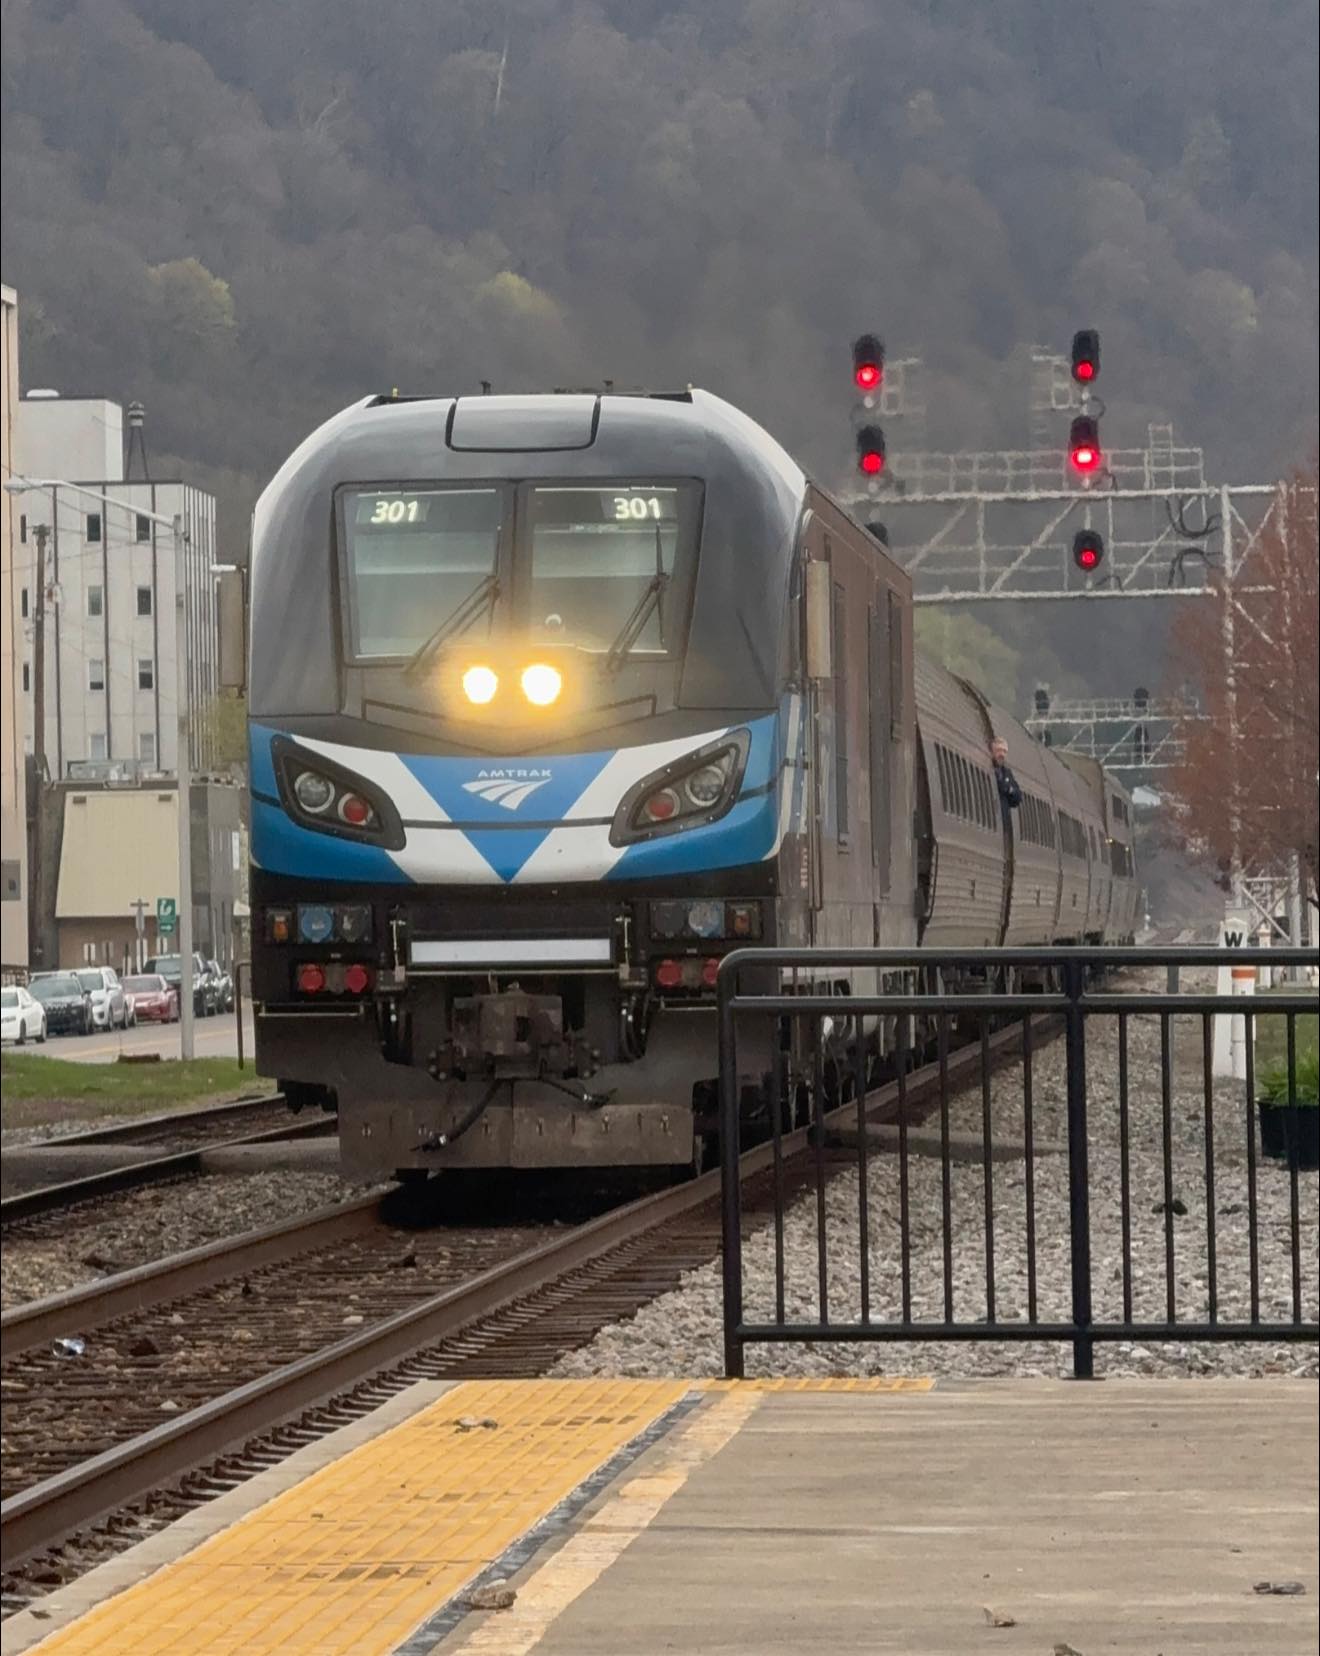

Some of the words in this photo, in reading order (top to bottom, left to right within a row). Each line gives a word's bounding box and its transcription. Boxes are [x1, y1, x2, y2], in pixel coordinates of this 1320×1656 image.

[371, 500, 418, 523] 301
[614, 497, 661, 519] 301
[478, 769, 552, 778] AMTRAK
[1225, 931, 1243, 948] W
